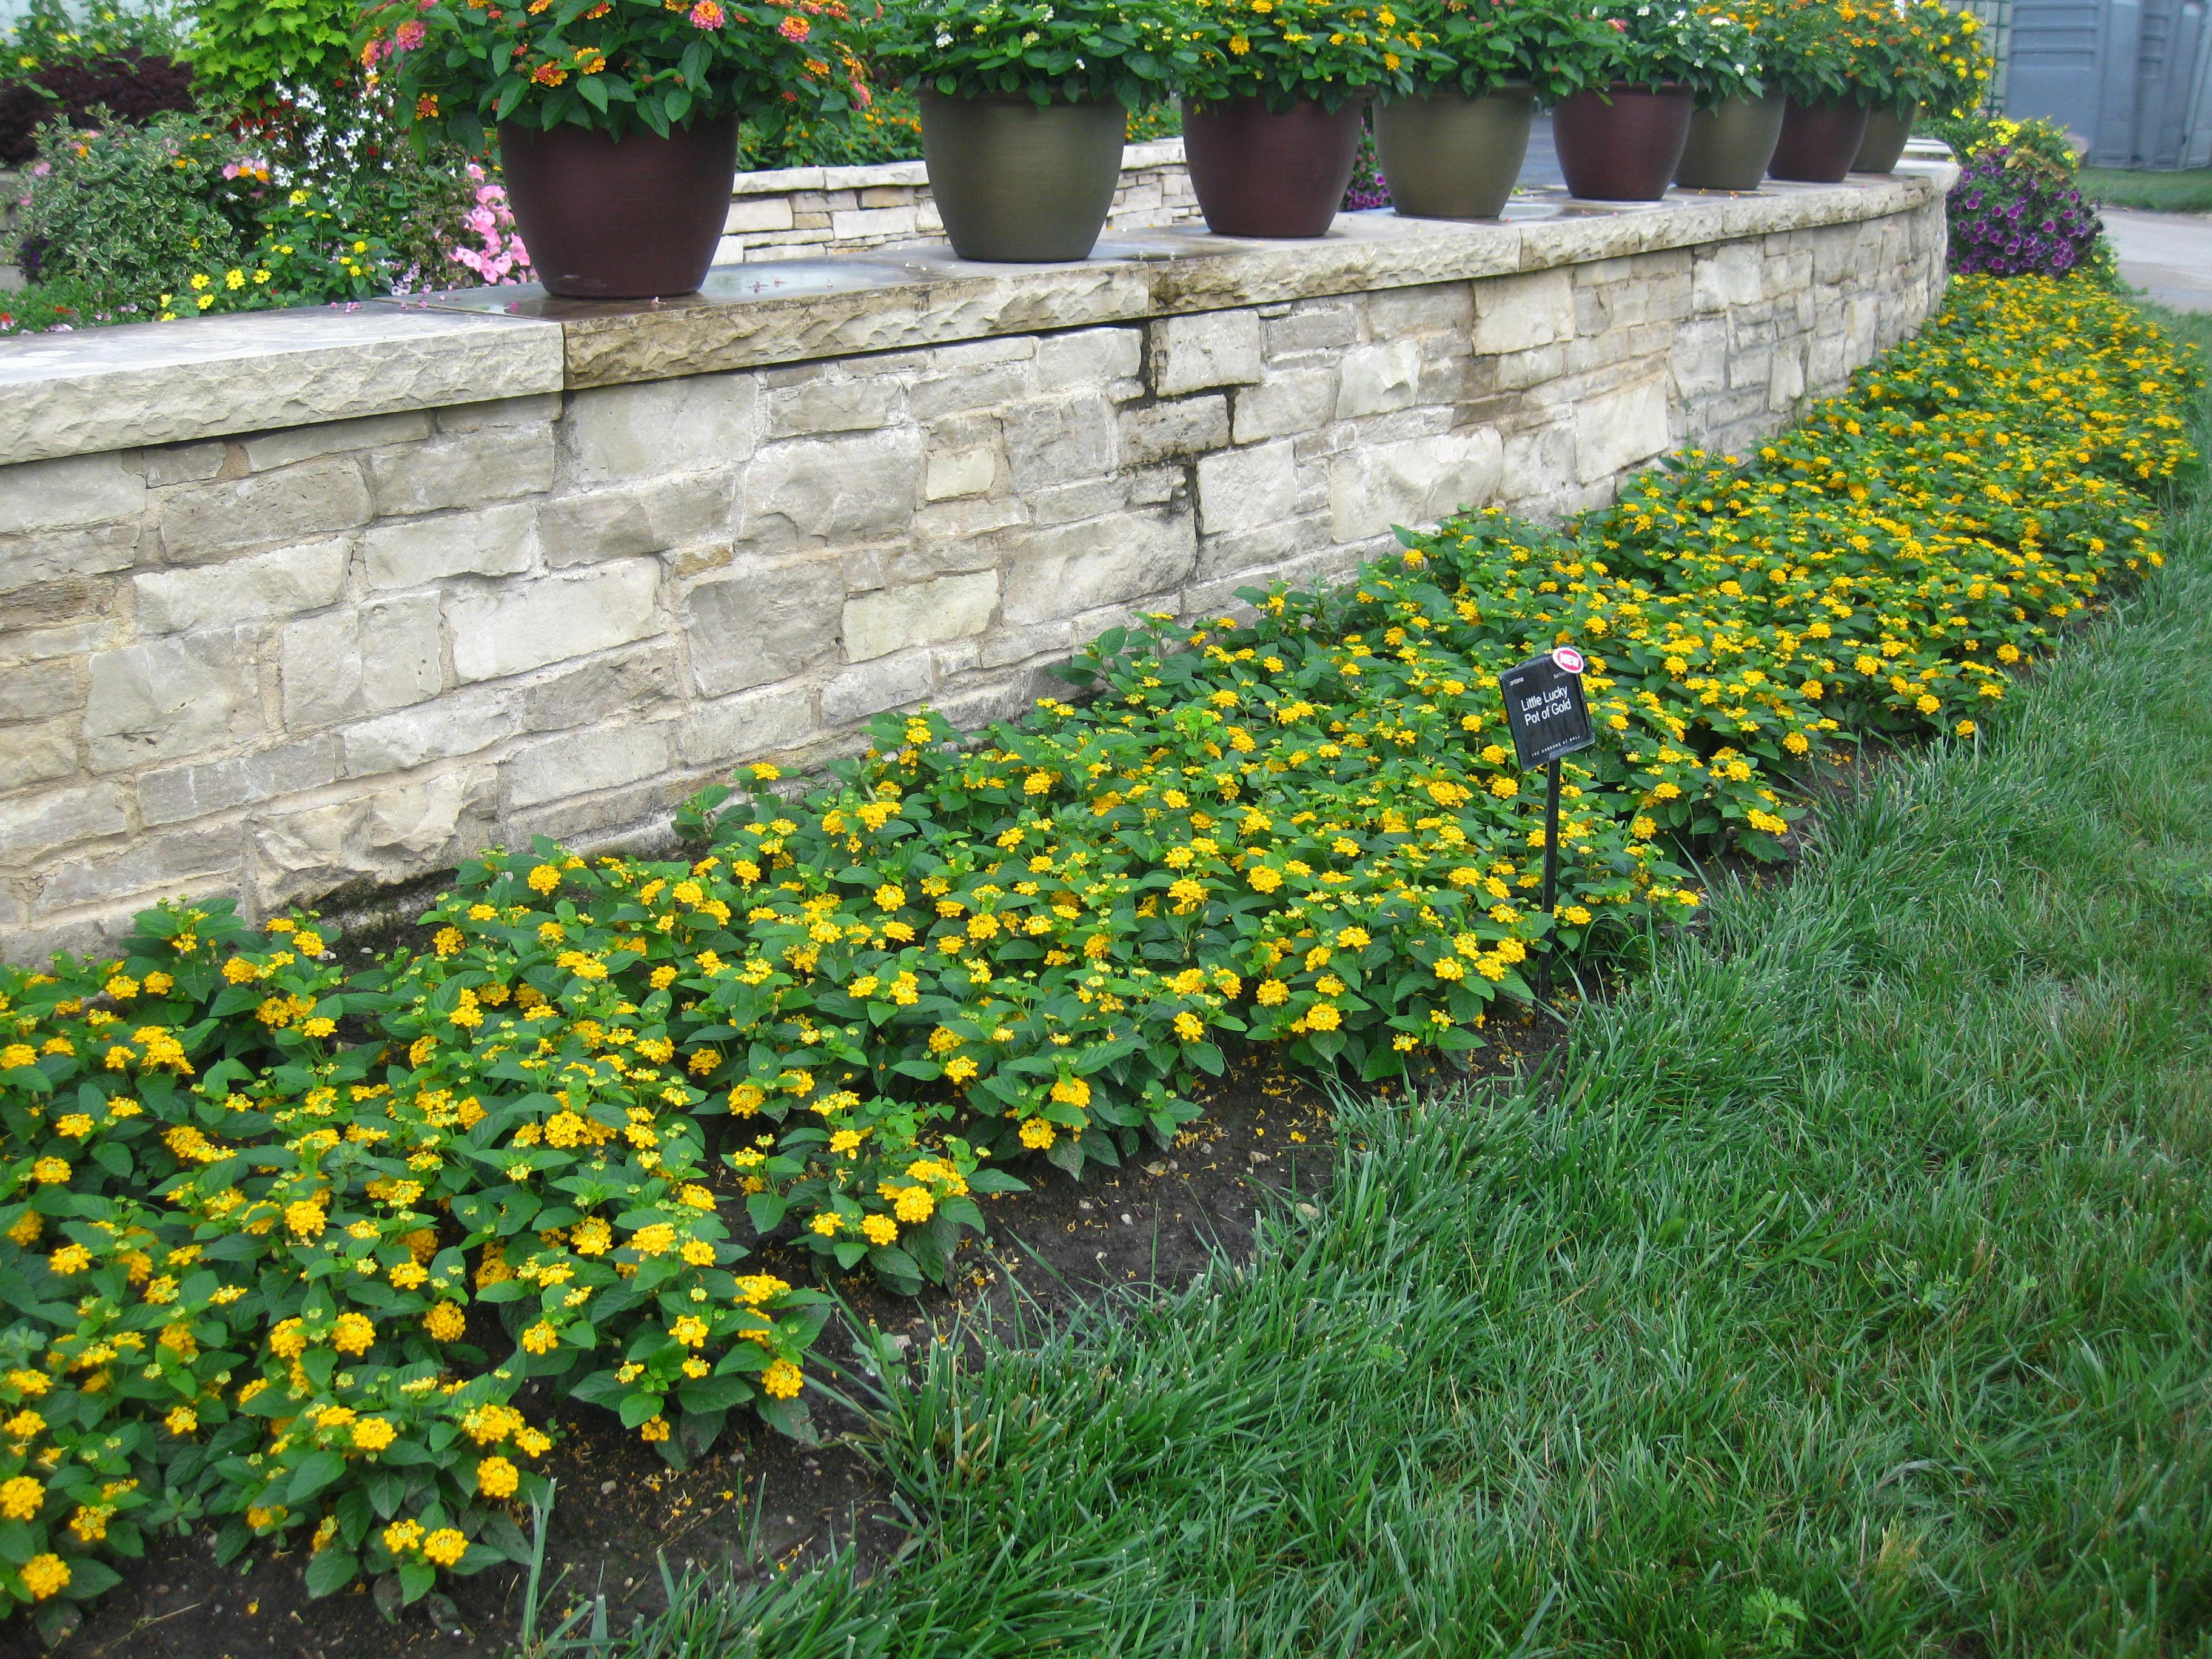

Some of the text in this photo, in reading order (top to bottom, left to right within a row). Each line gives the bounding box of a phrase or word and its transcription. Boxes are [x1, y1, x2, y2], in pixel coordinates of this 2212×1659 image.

[1560, 652, 1578, 668] NEW
[1520, 685, 1568, 712] Little Lucky
[1524, 698, 1572, 726] Pot of Gold
